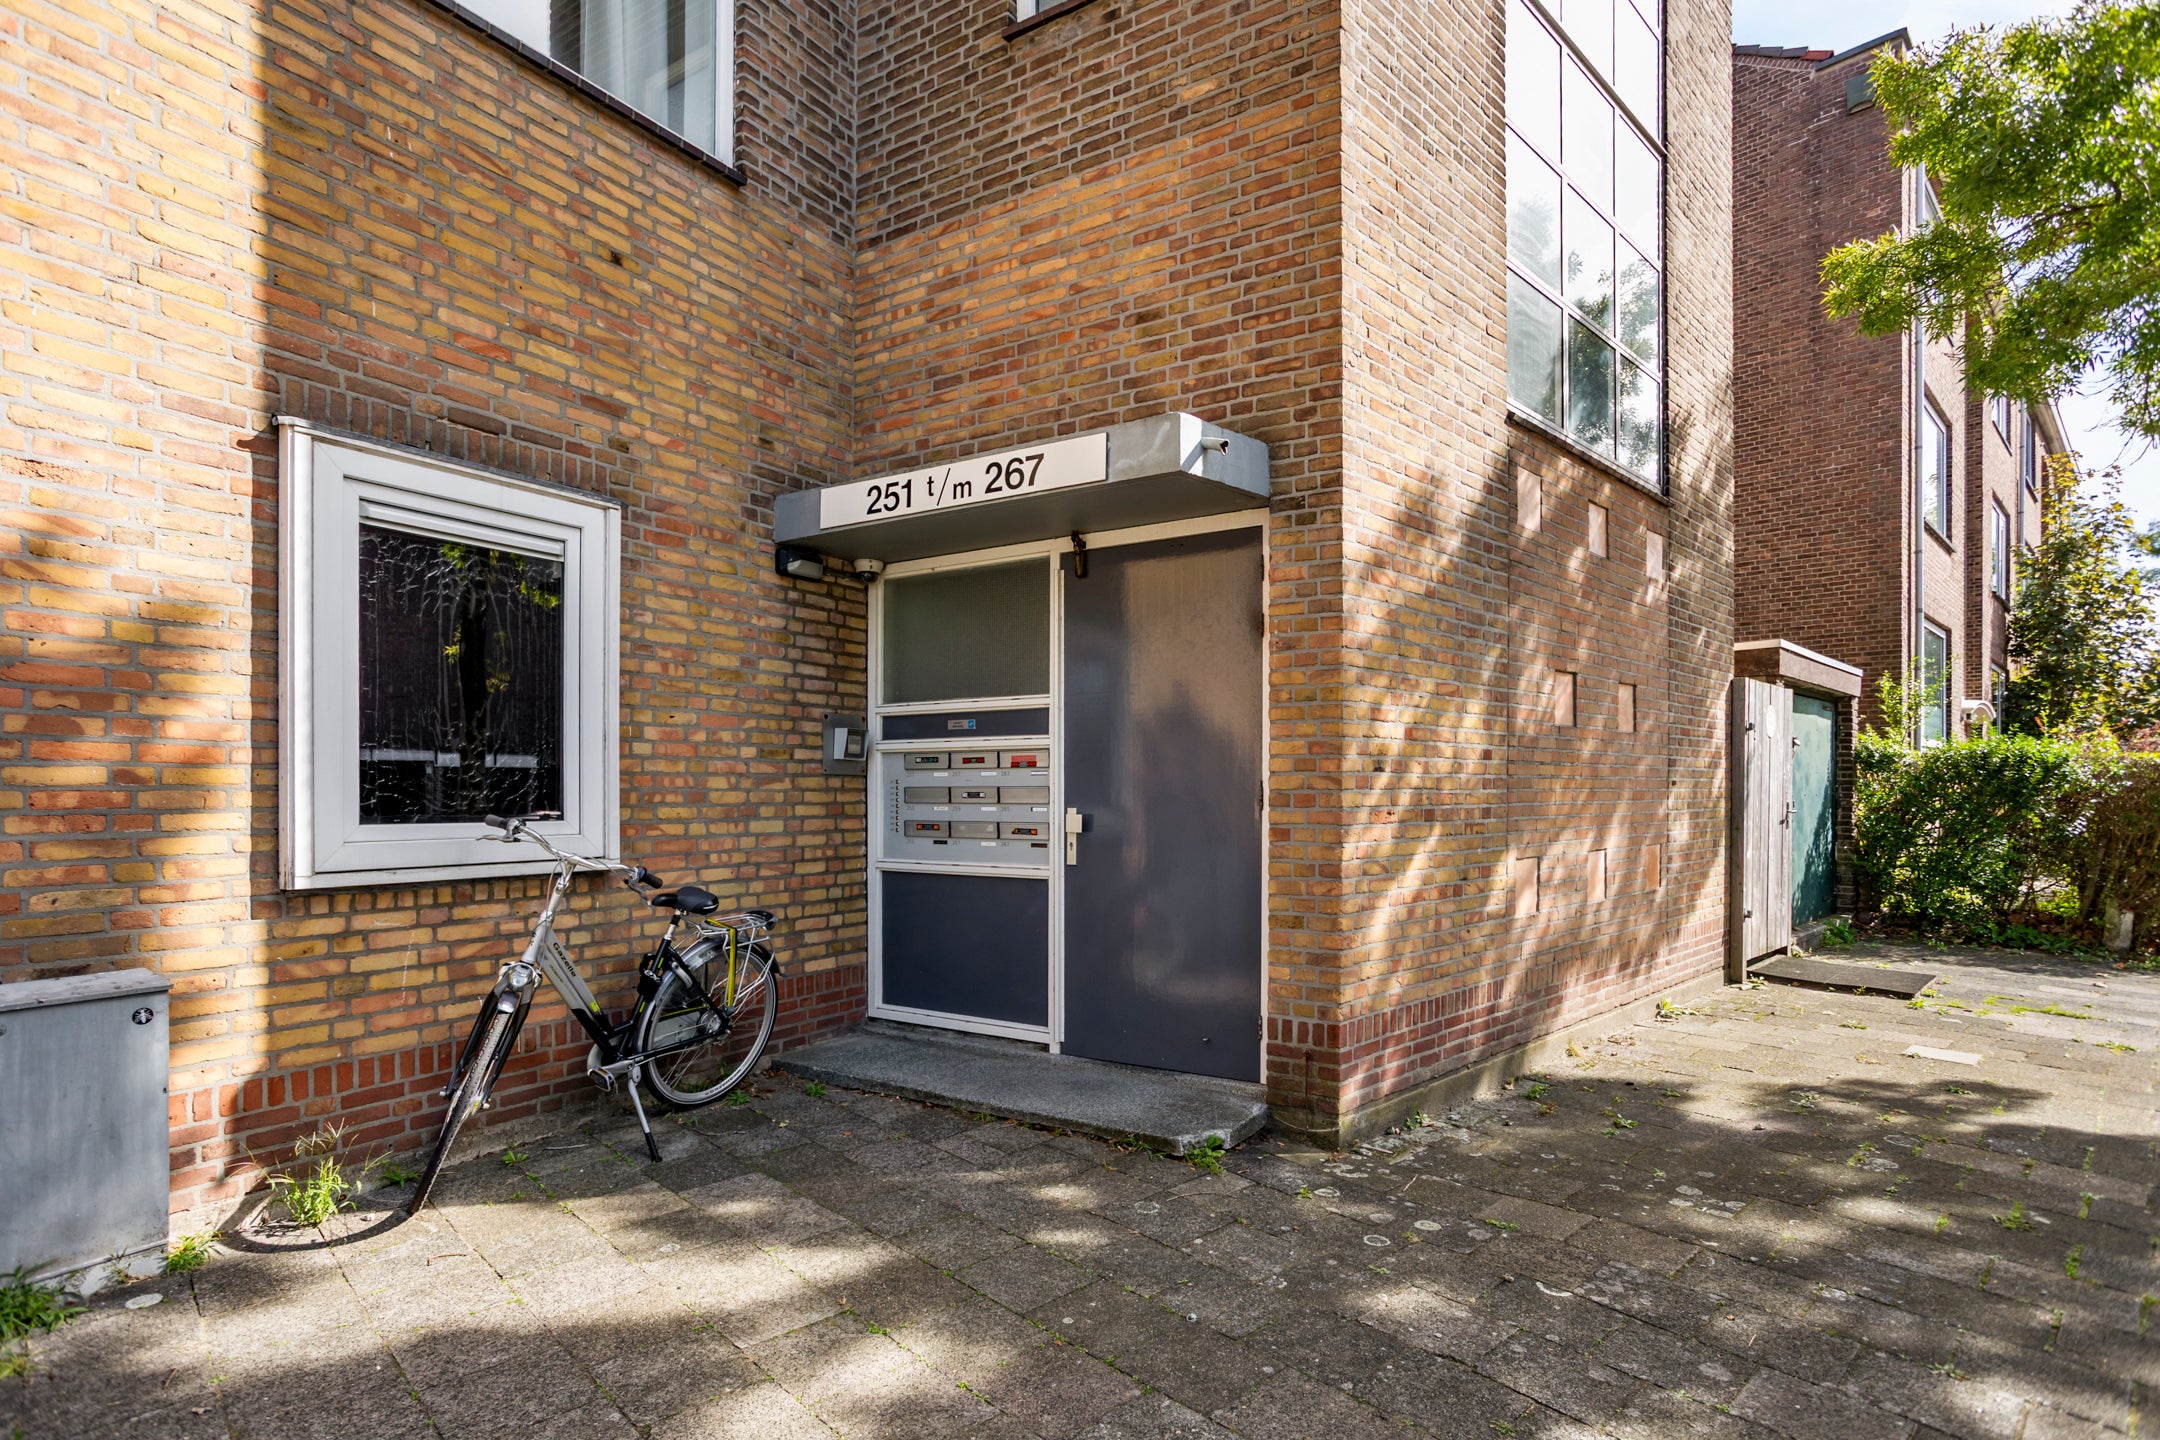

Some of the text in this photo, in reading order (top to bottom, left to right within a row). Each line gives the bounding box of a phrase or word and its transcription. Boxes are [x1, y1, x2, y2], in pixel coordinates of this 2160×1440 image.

[866, 453, 1045, 515] 251 t/m 267
[553, 942, 577, 978] Gazelle
